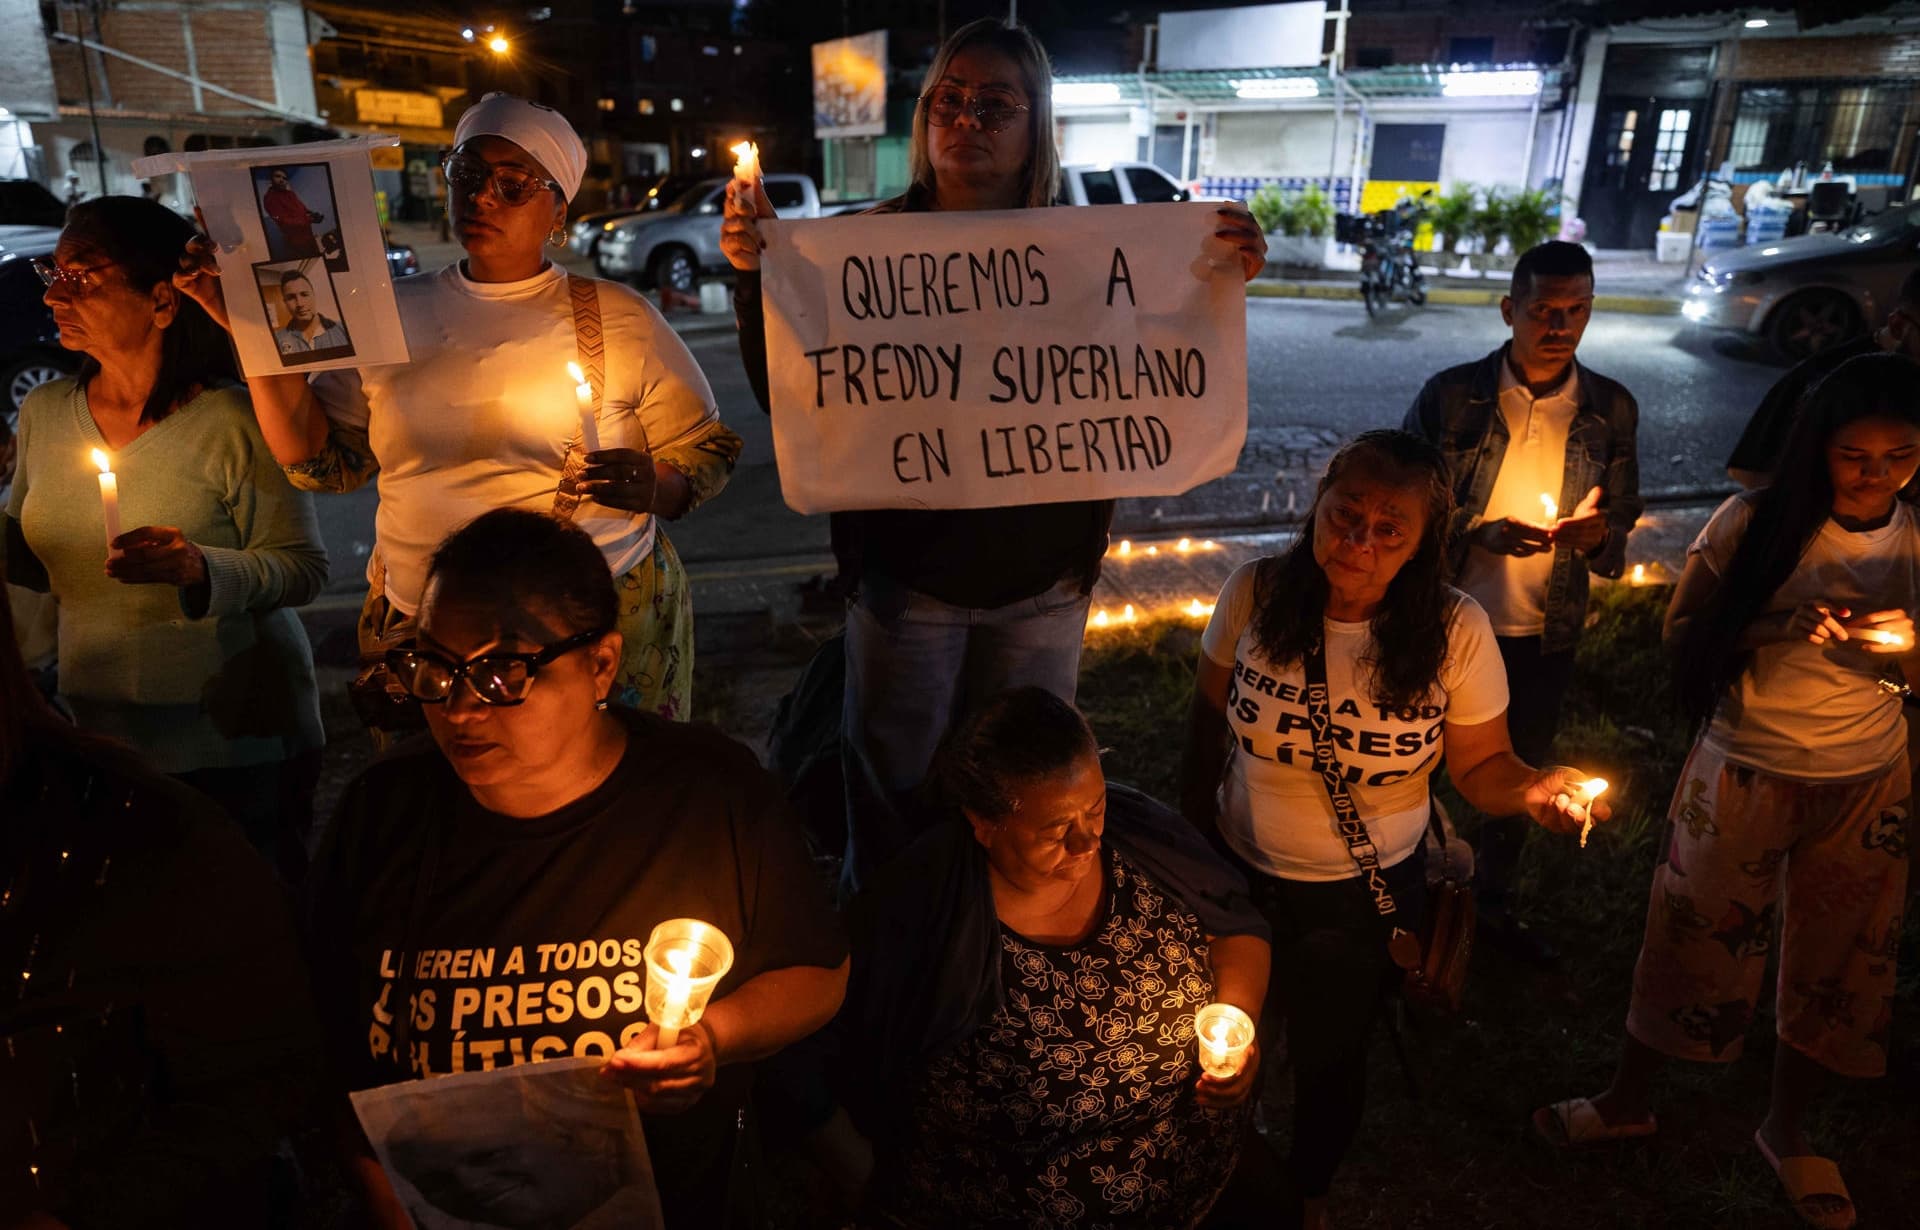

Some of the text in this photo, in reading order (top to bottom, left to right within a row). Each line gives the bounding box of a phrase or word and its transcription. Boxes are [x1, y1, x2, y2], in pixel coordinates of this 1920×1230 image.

[842, 244, 1136, 320] QUEREMOS A
[804, 343, 1206, 407] FREDDY SUPERLANO
[893, 415, 1172, 483] EN LIBERTAD
[1335, 699, 1362, 717] A
[379, 938, 642, 979] LEREN A TODOS
[450, 970, 643, 1030] PRESOS
